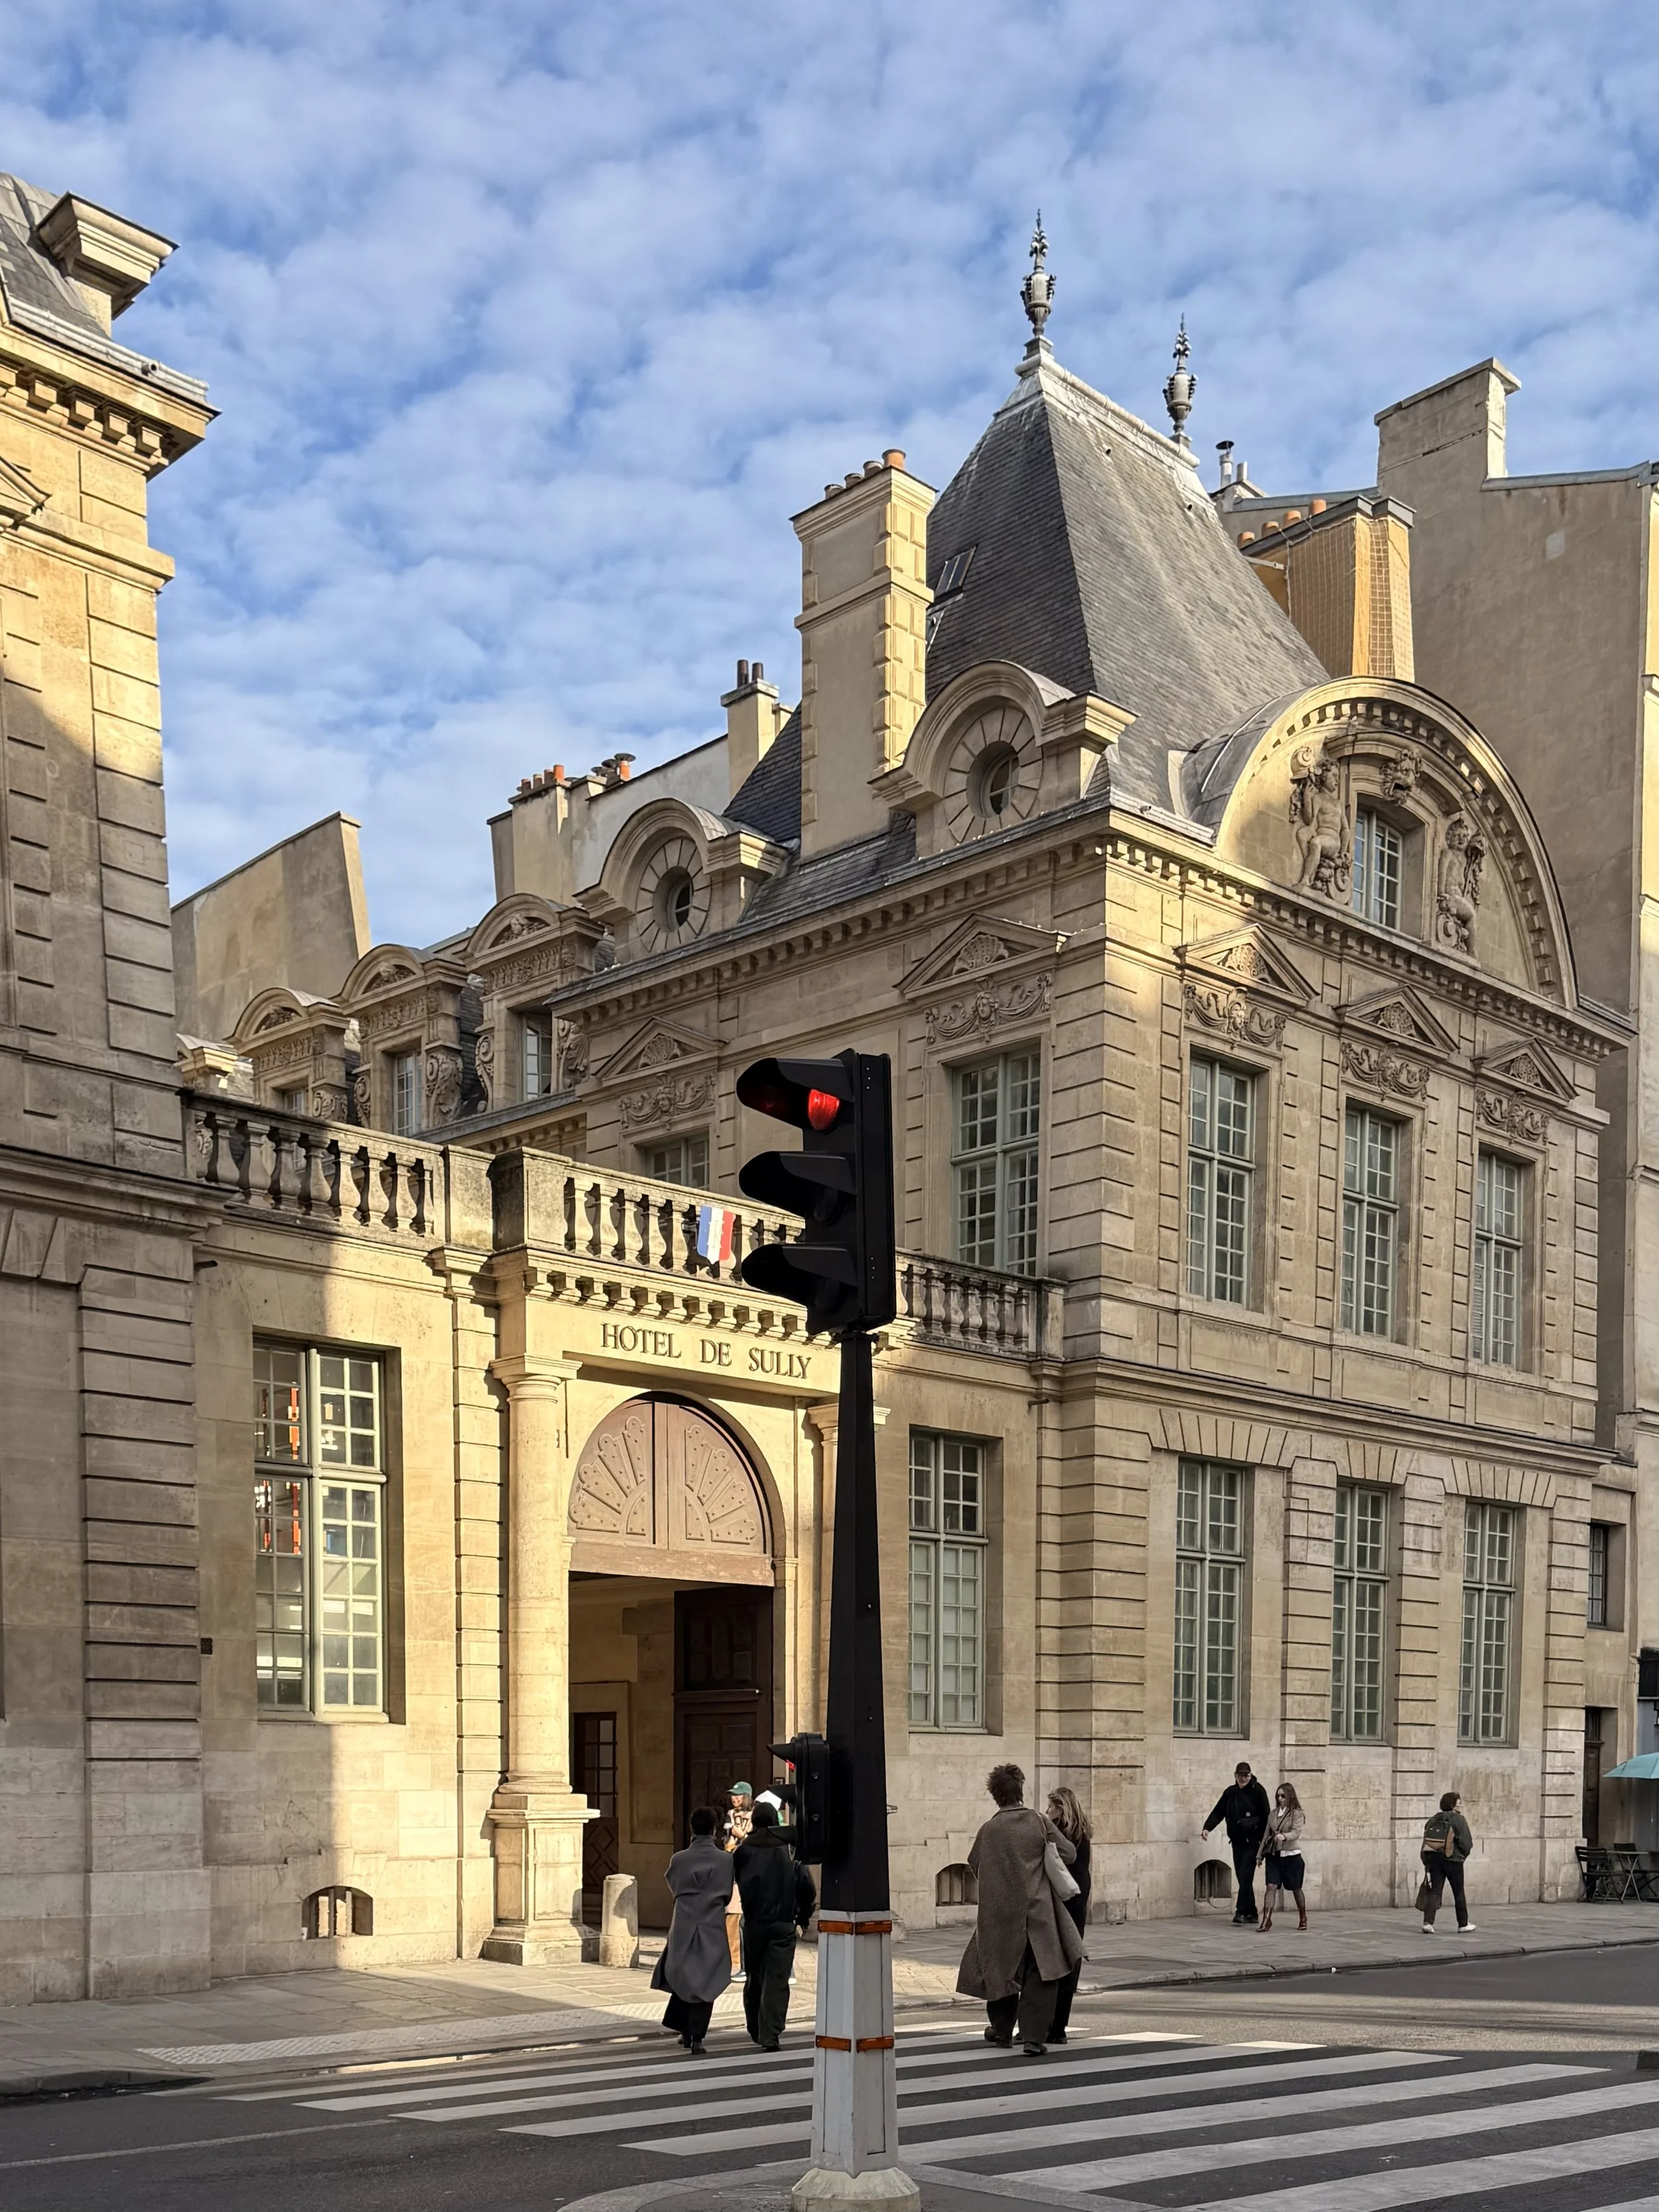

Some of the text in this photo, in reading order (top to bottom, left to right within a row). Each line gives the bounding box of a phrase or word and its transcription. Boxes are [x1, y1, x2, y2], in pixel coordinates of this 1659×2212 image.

[600, 1322, 812, 1379] HOTEL DE SULLY
